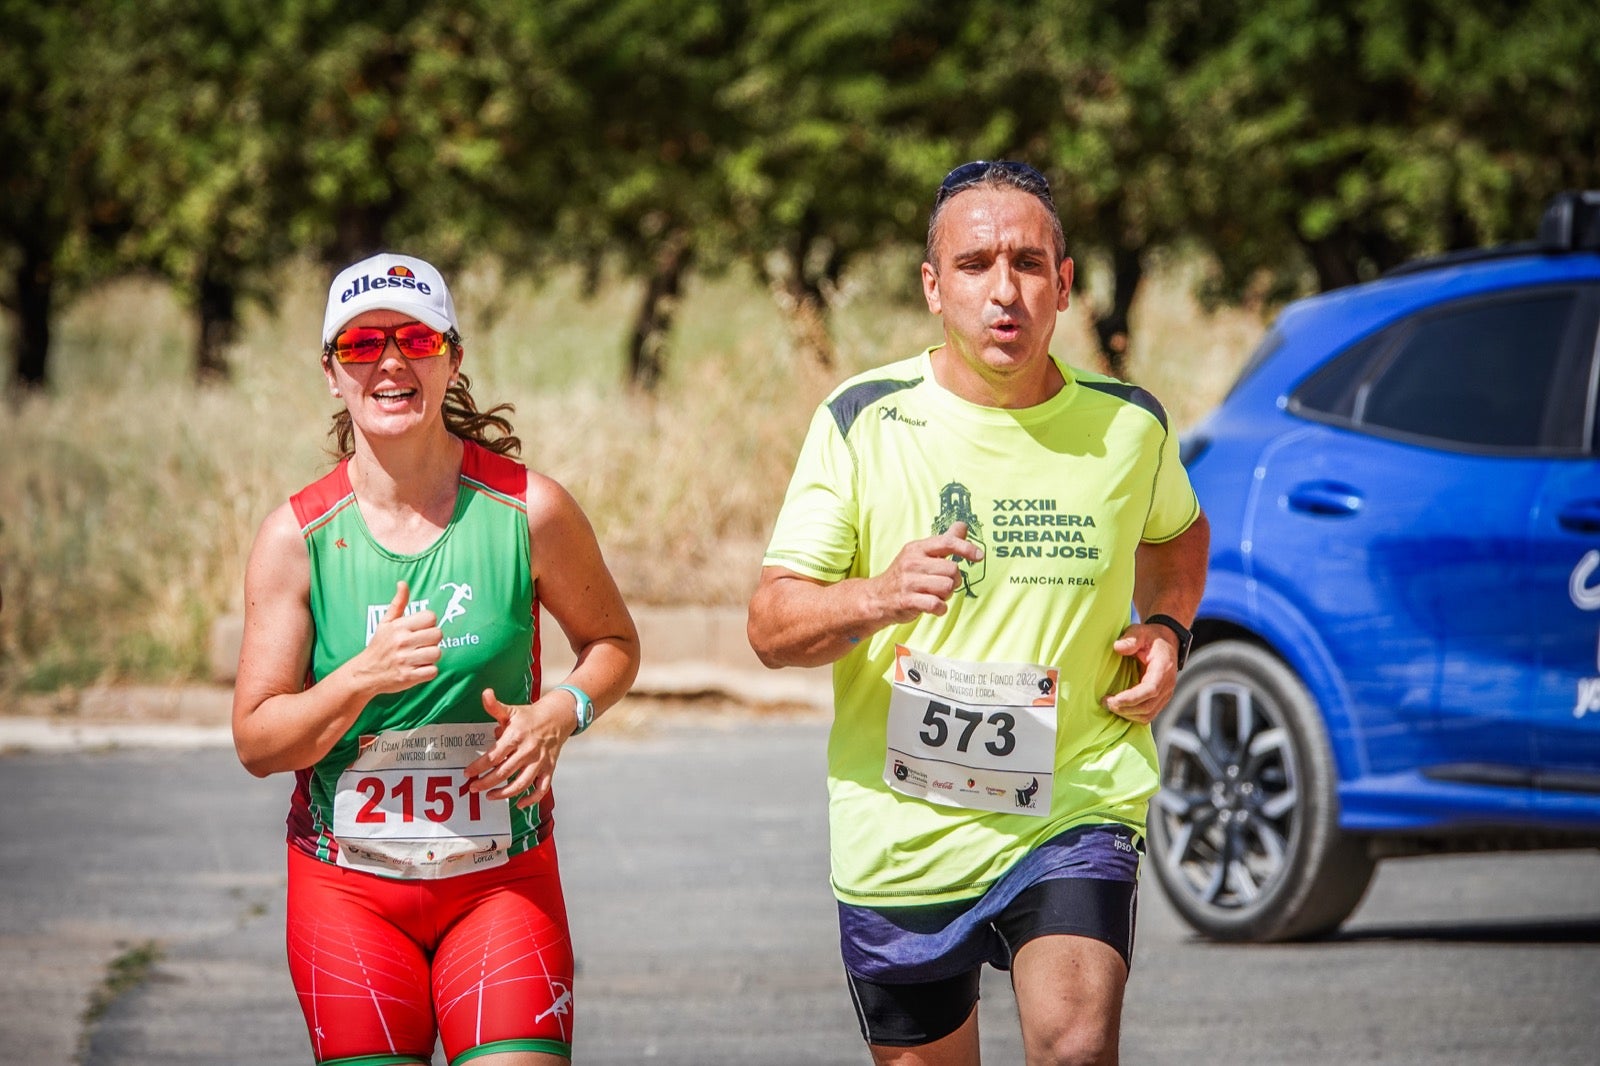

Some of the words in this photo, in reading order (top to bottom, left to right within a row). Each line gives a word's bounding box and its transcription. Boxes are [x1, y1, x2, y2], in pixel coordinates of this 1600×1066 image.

[341, 274, 431, 303] ellesse
[992, 499, 1057, 511] XXXIII
[992, 514, 1096, 528] CARRERA
[992, 530, 1086, 543] URBANA
[1009, 576, 1064, 586] MANCHA
[1067, 577, 1096, 586] REAL
[1016, 672, 1038, 687] 2022
[919, 700, 1016, 757] 573
[464, 732, 486, 747] 2022
[355, 776, 481, 823] 2151
